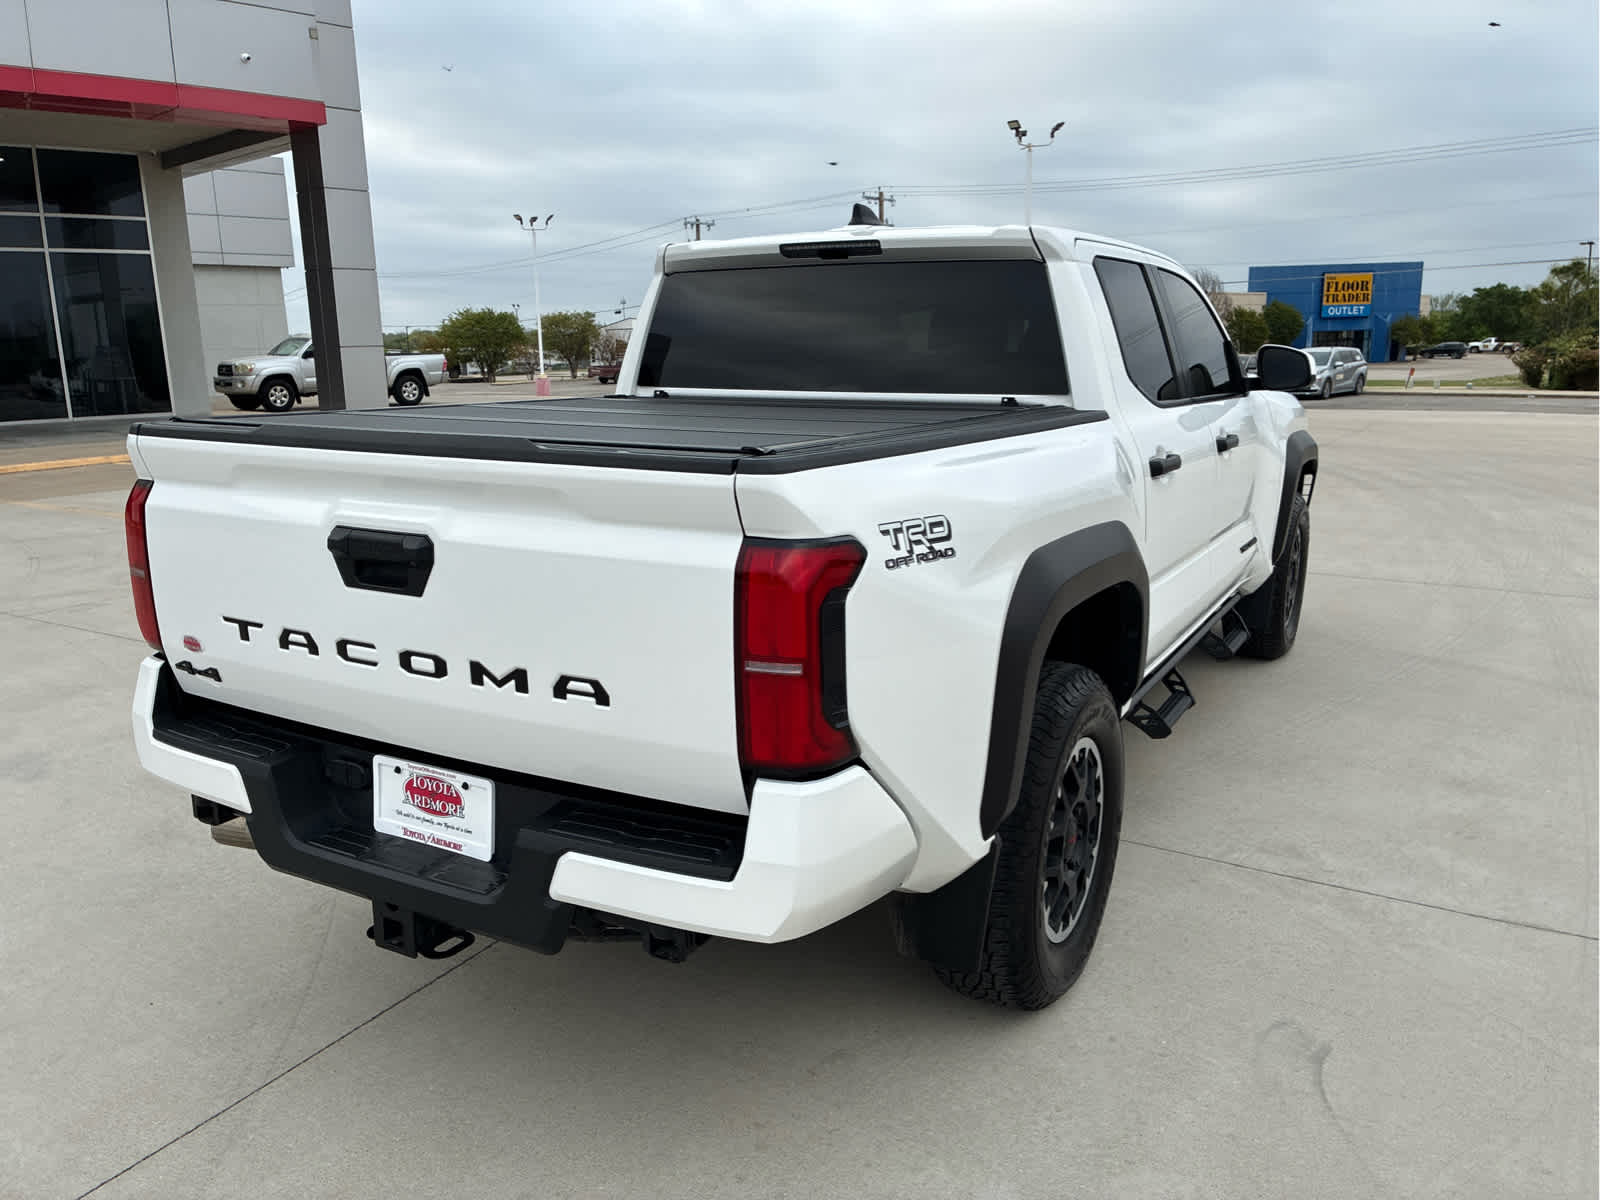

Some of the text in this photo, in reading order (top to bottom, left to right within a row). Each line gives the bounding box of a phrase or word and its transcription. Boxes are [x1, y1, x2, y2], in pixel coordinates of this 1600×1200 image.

[1324, 292, 1370, 303] TRADER
[1326, 280, 1369, 292] FLOOR
[1327, 306, 1365, 315] OUTLET
[878, 514, 952, 555] TRD
[885, 547, 956, 570] OFF ROAD
[222, 615, 611, 707] TACOMA
[410, 771, 457, 798] TOYOTA
[402, 789, 465, 819] ARDMORE
